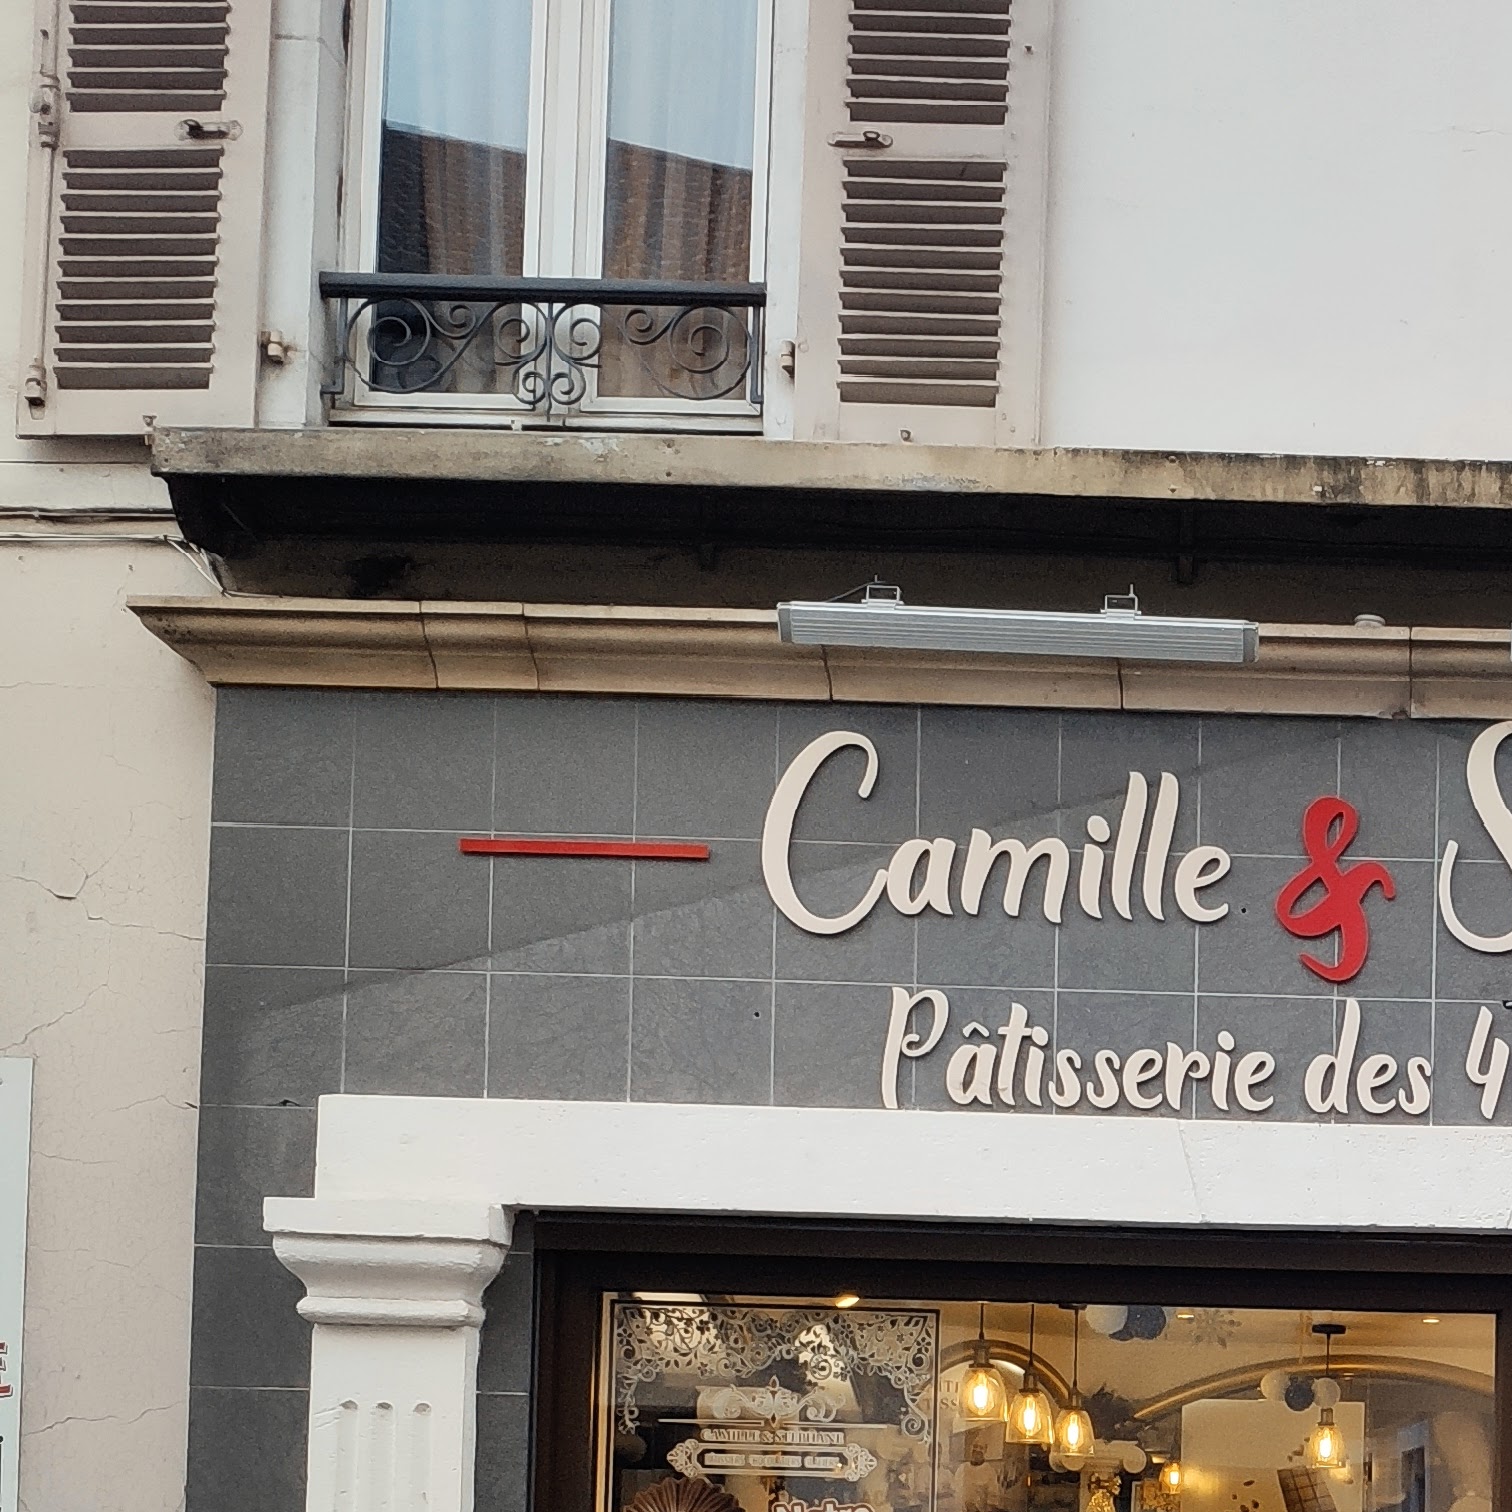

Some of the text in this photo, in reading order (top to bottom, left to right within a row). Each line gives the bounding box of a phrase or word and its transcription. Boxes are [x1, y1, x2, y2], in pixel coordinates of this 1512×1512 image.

[761, 731, 1231, 934] Camille
[1276, 796, 1396, 981] &
[881, 986, 1275, 1112] Pâtisserie
[1305, 998, 1432, 1114] des
[1465, 1006, 1510, 1119] 4
